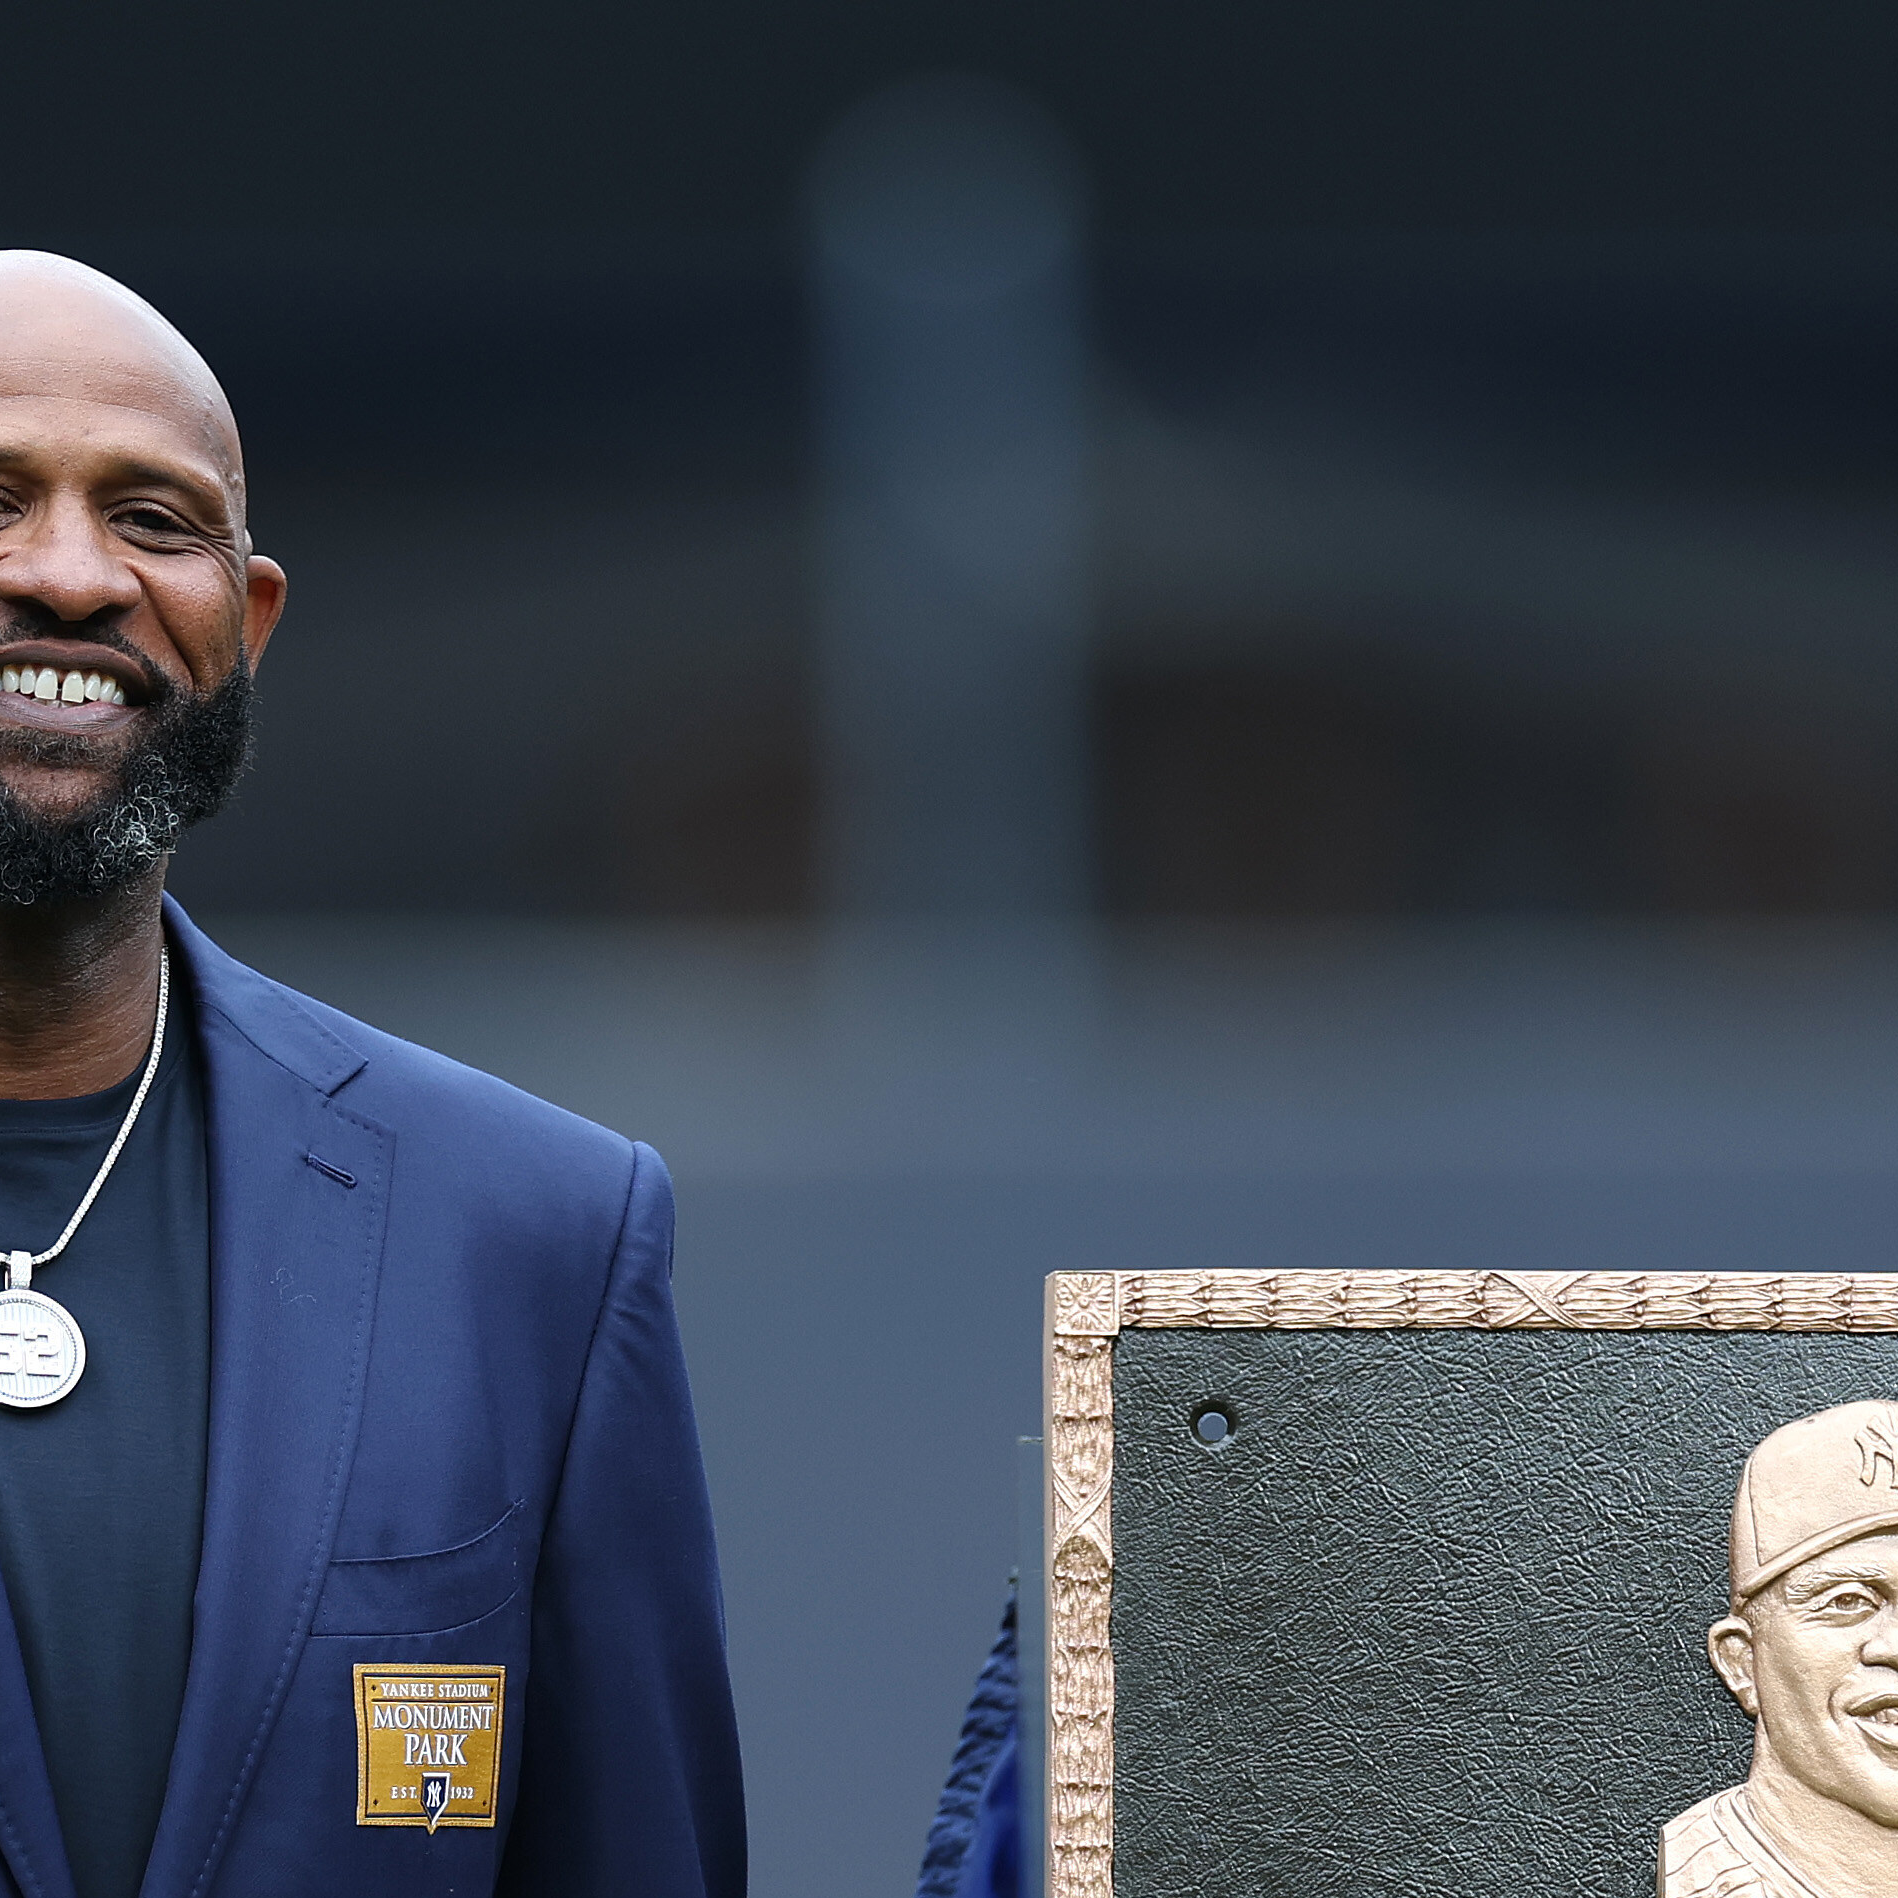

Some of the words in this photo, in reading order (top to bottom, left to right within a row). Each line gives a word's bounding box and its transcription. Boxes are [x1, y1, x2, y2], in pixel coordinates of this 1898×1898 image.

[380, 1682, 434, 1698] YANKEE
[438, 1683, 489, 1698] STADIUM
[373, 1704, 495, 1731] MONUMENT
[404, 1733, 469, 1766] PARK
[391, 1786, 418, 1800] EST.
[450, 1786, 474, 1800] 1932
